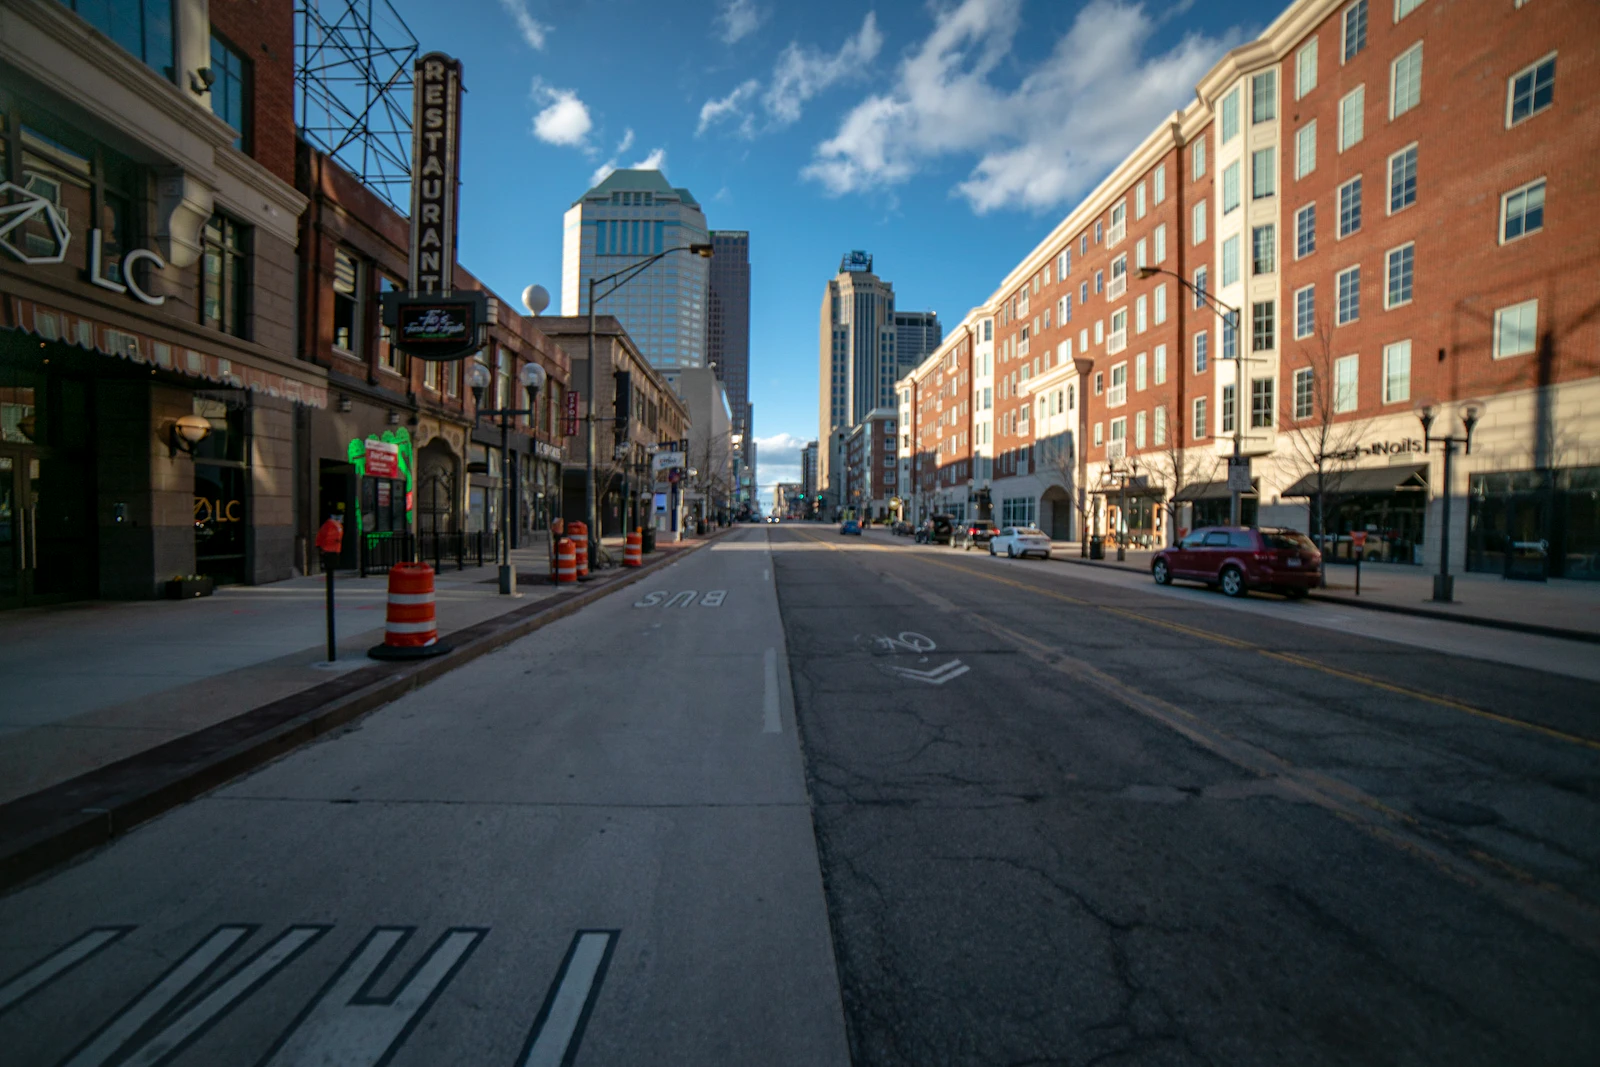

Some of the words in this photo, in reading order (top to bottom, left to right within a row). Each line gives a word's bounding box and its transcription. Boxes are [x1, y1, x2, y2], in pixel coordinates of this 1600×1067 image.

[421, 60, 444, 295] RESTAURANT
[91, 228, 166, 305] LC
[216, 499, 241, 523] LC
[633, 589, 729, 609] BUS
